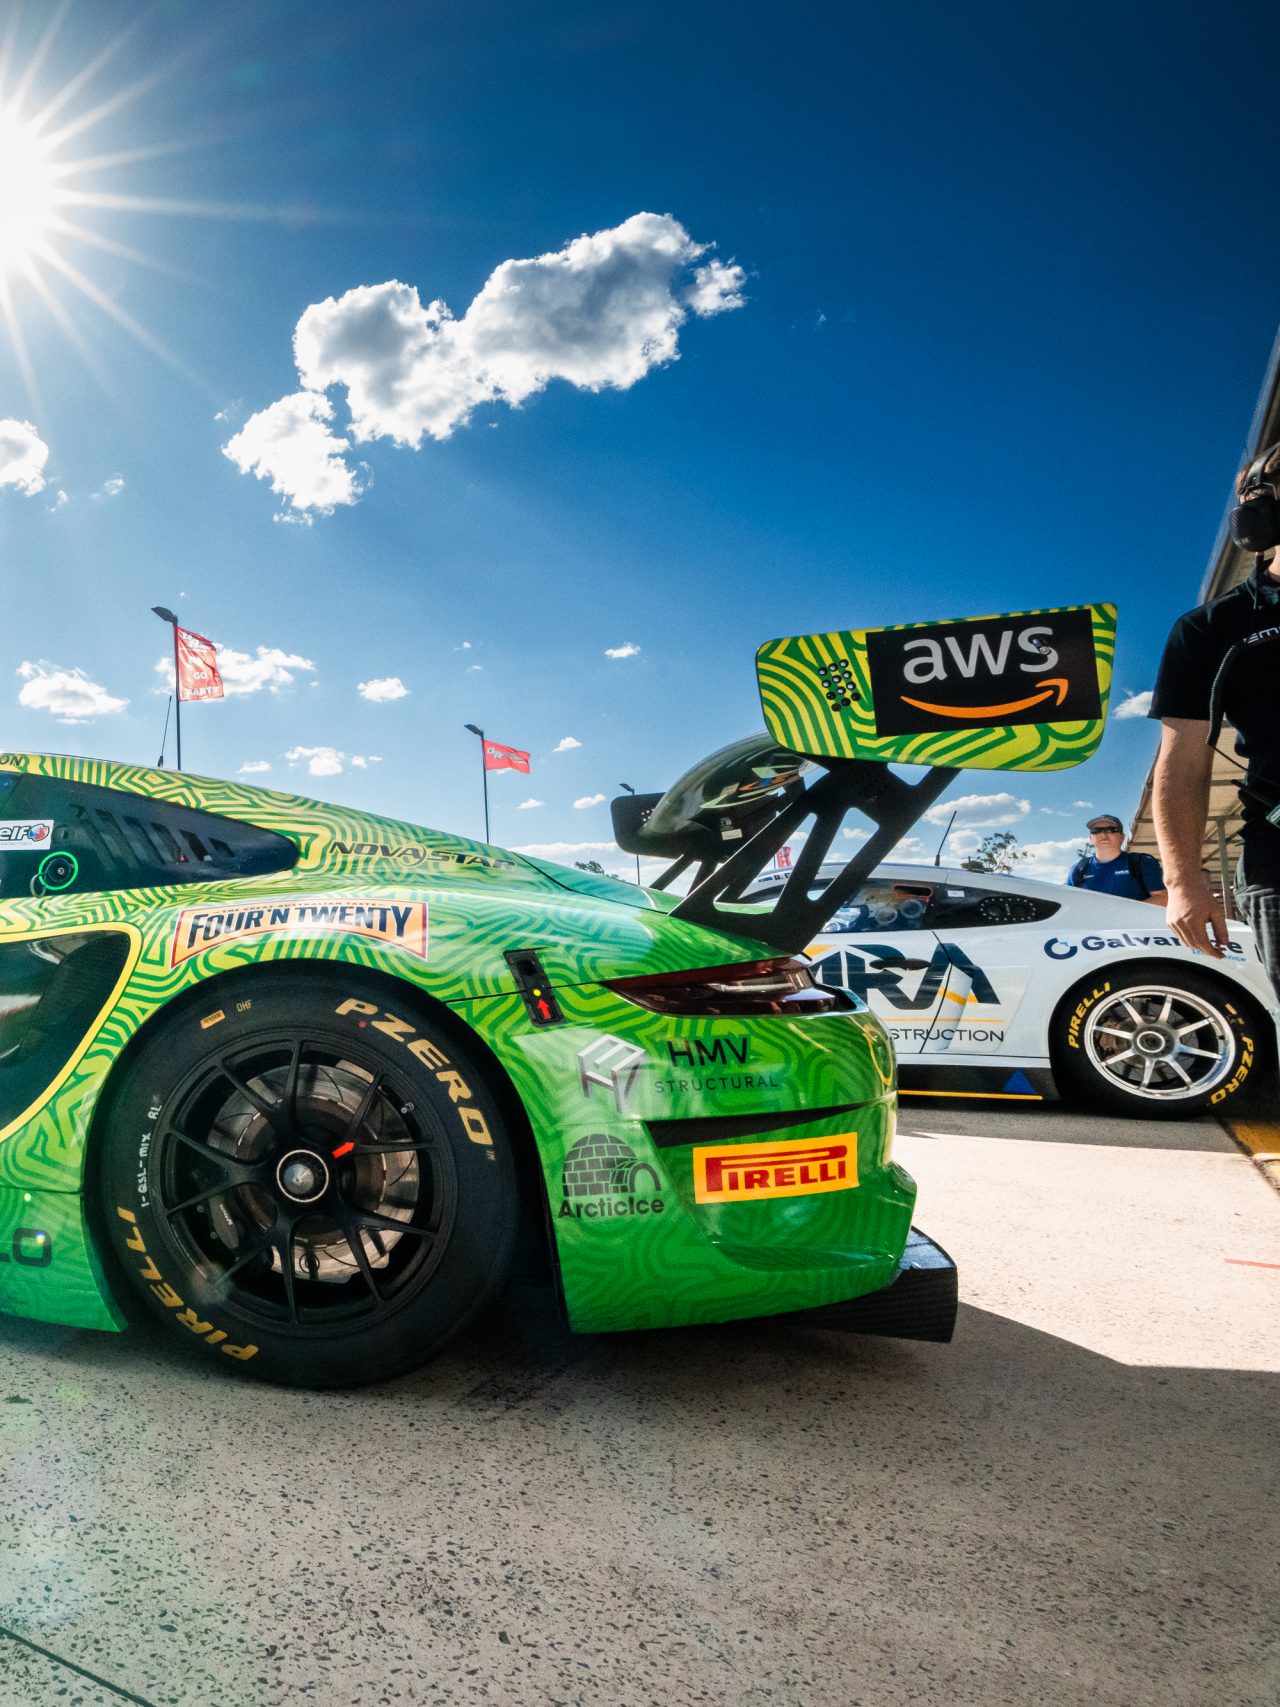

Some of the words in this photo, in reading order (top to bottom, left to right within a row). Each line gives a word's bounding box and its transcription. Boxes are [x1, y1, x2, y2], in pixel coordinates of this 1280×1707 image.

[903, 626, 1059, 684] aws
[294, 905, 413, 938] TWENTY
[1068, 982, 1111, 1048] PIRELLI
[888, 1028, 1005, 1042] STRUCTION
[668, 1037, 748, 1067] HMV
[654, 1074, 778, 1093] STRUCTURAL
[705, 1145, 848, 1192] PIRELLI
[558, 1197, 665, 1218] ArcticIce
[117, 1207, 259, 1360] PIRELLI
